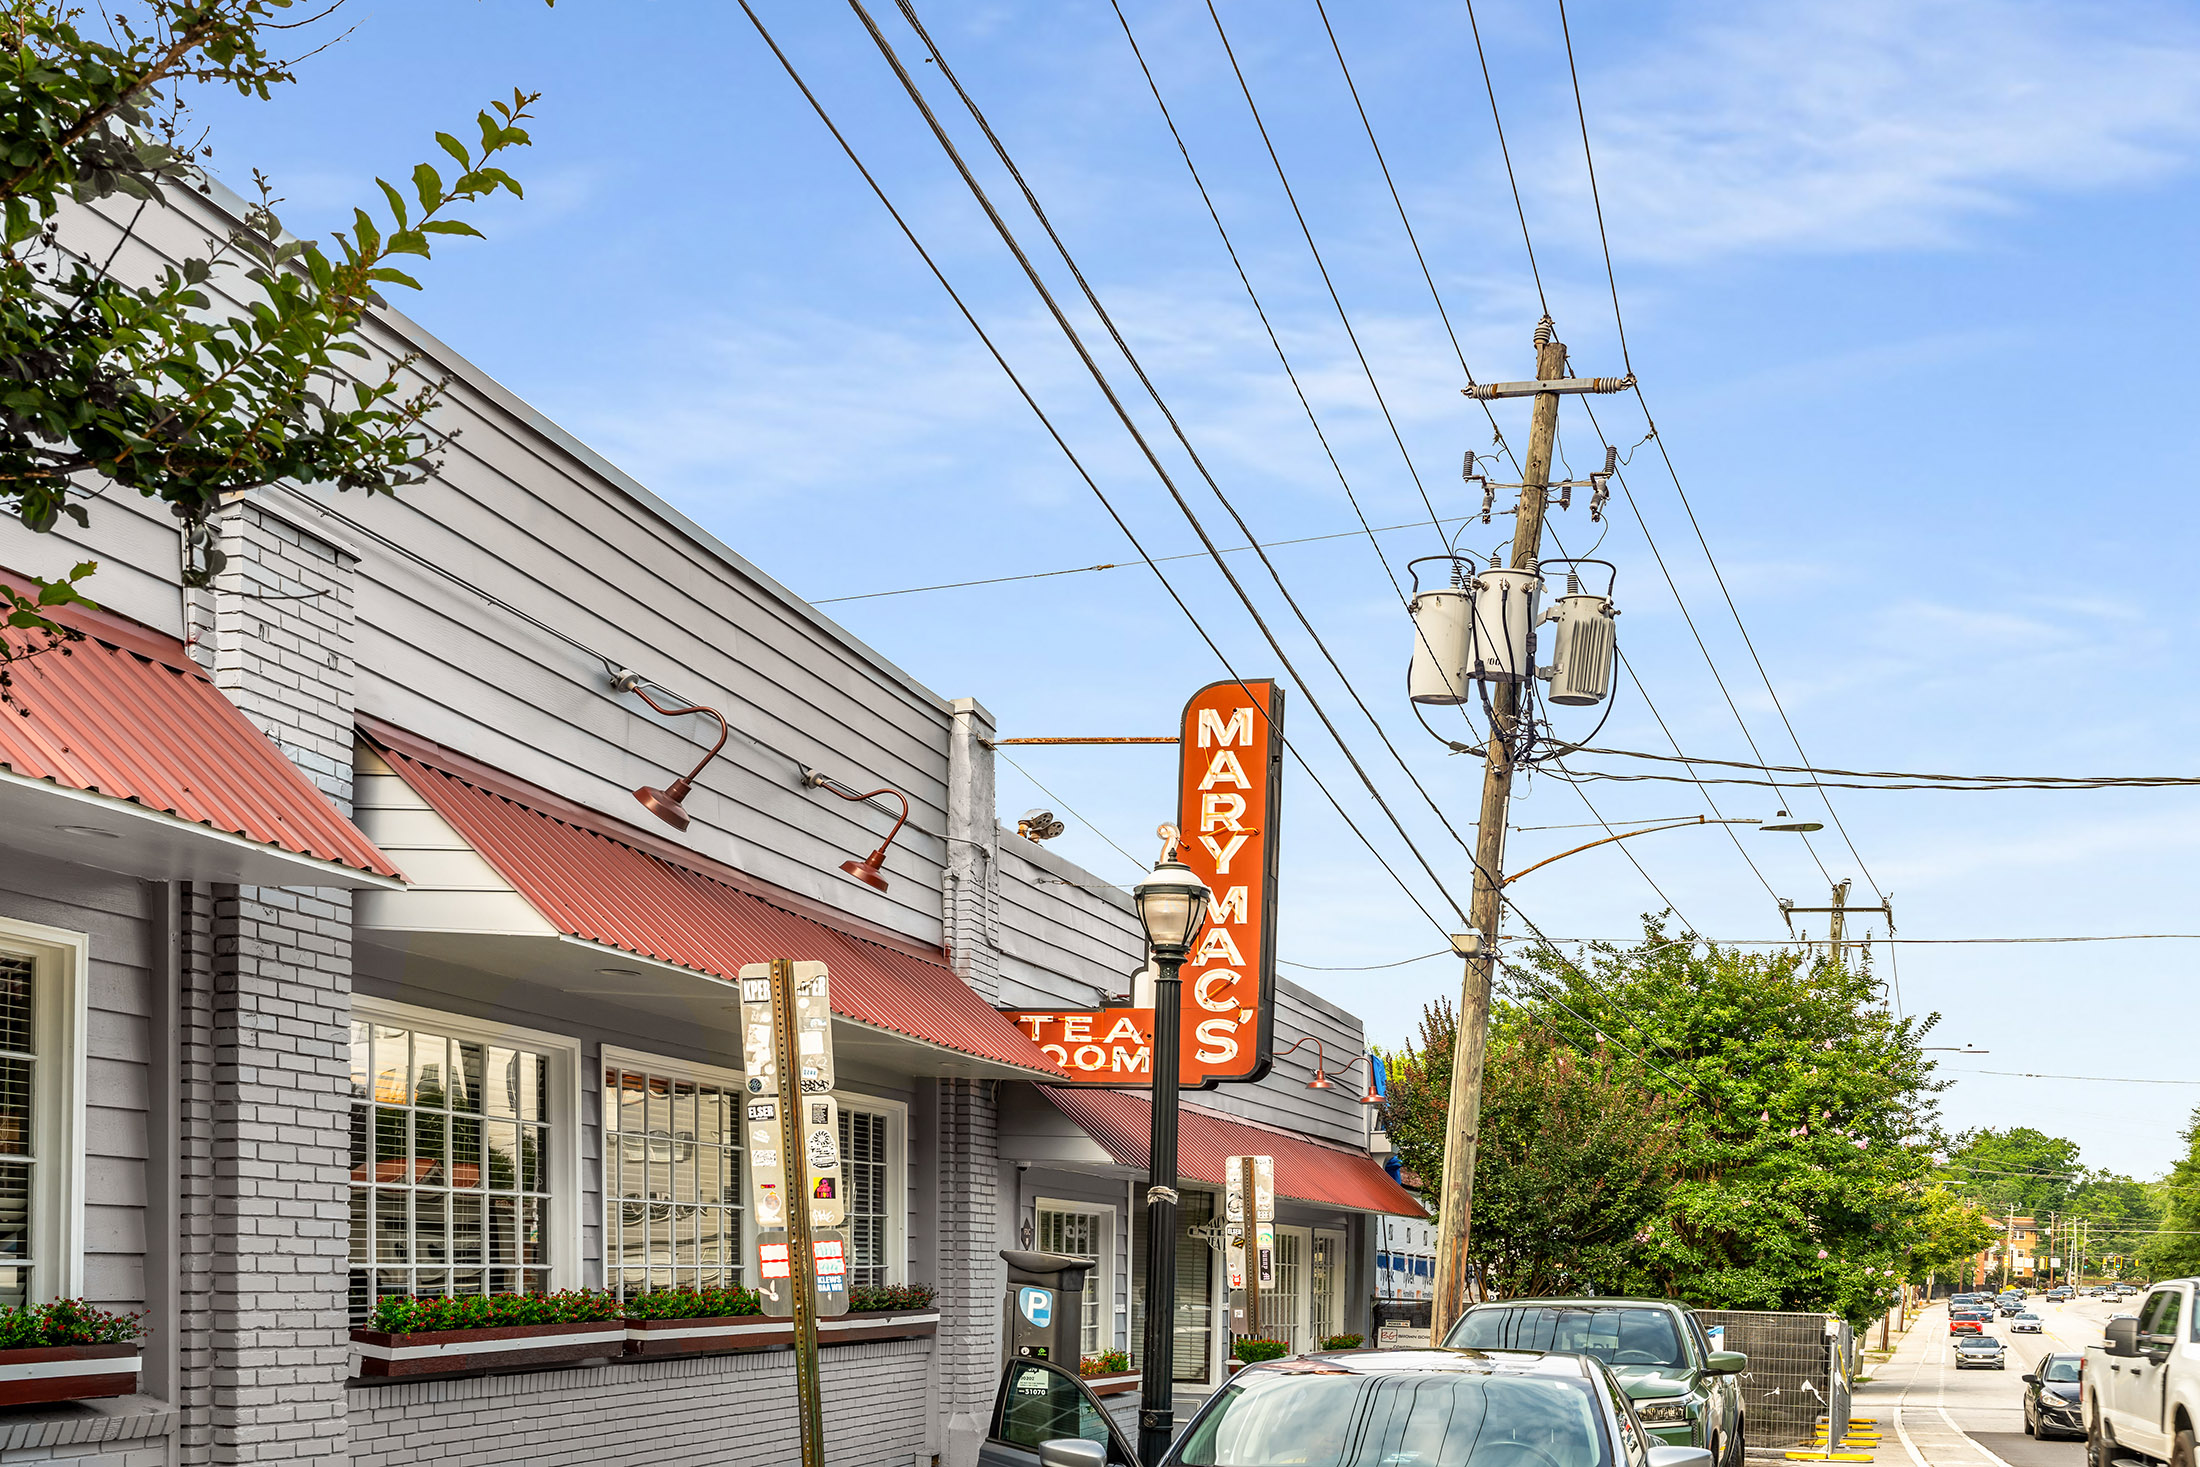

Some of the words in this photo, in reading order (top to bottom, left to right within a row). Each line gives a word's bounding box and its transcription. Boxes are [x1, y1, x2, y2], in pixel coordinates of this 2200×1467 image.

[1197, 707, 1254, 875] MARY
[1019, 1015, 1145, 1045] TEA
[1040, 1043, 1151, 1074] OOM
[1027, 1291, 1048, 1319] P
